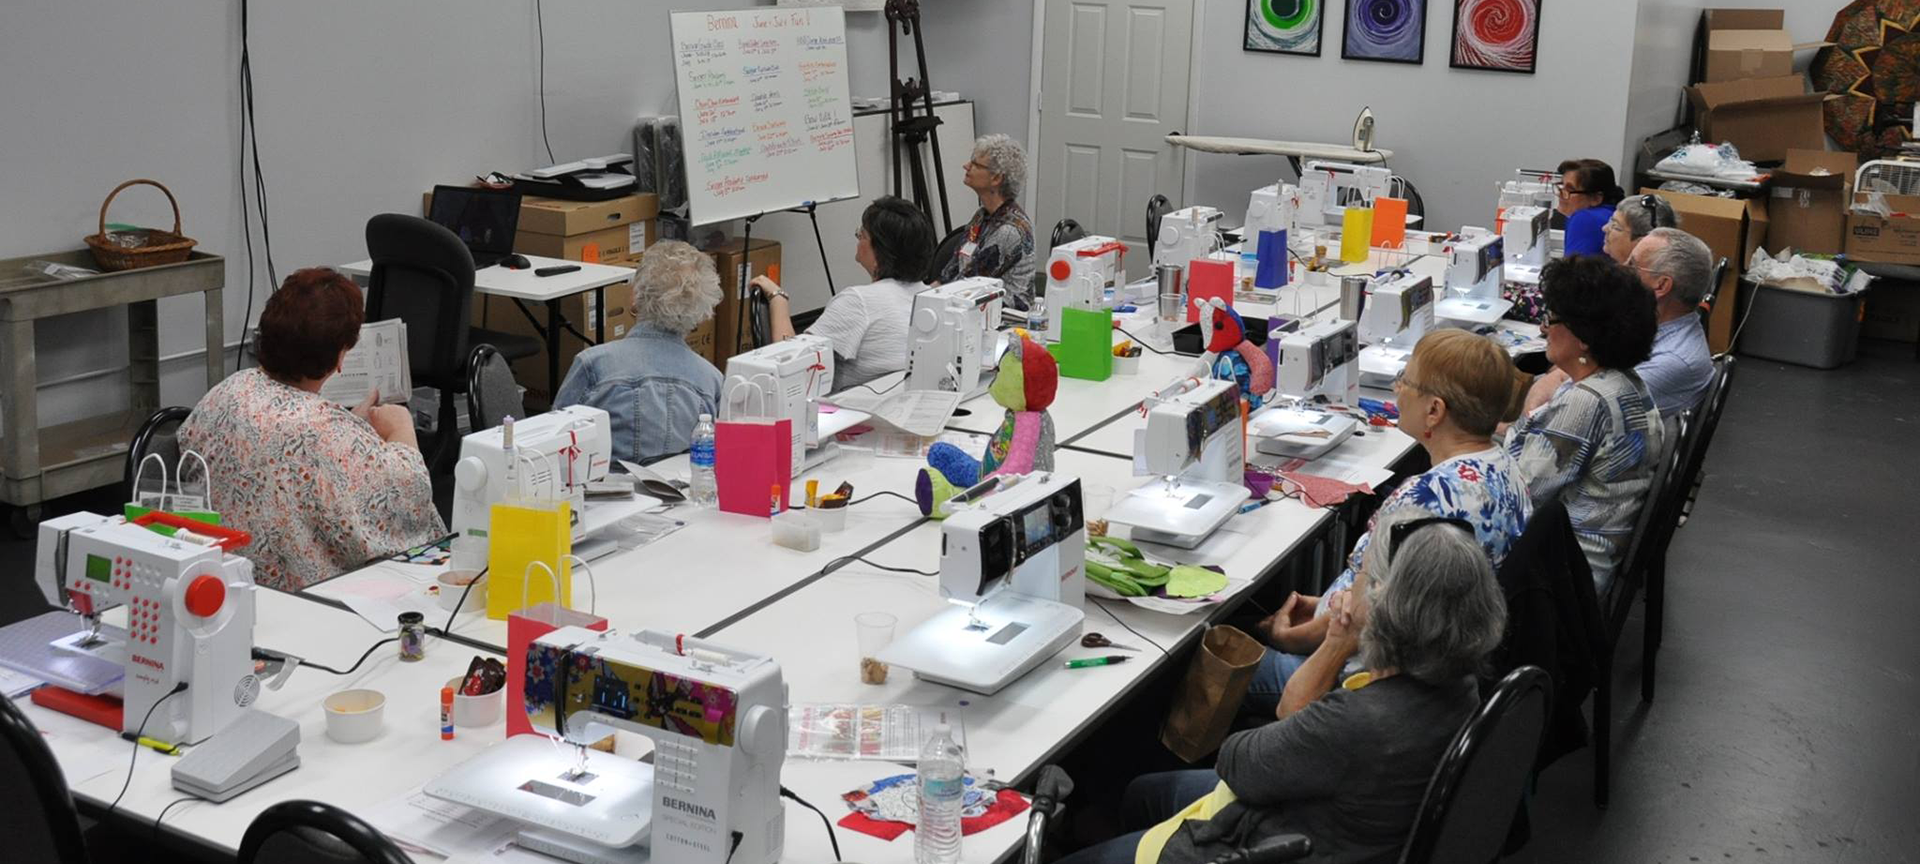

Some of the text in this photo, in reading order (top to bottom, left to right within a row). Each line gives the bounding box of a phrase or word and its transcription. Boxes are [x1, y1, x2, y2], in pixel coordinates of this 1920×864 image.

[707, 14, 739, 31] Bernina
[132, 654, 165, 671] BERNINA
[662, 796, 717, 821] BERNINA
